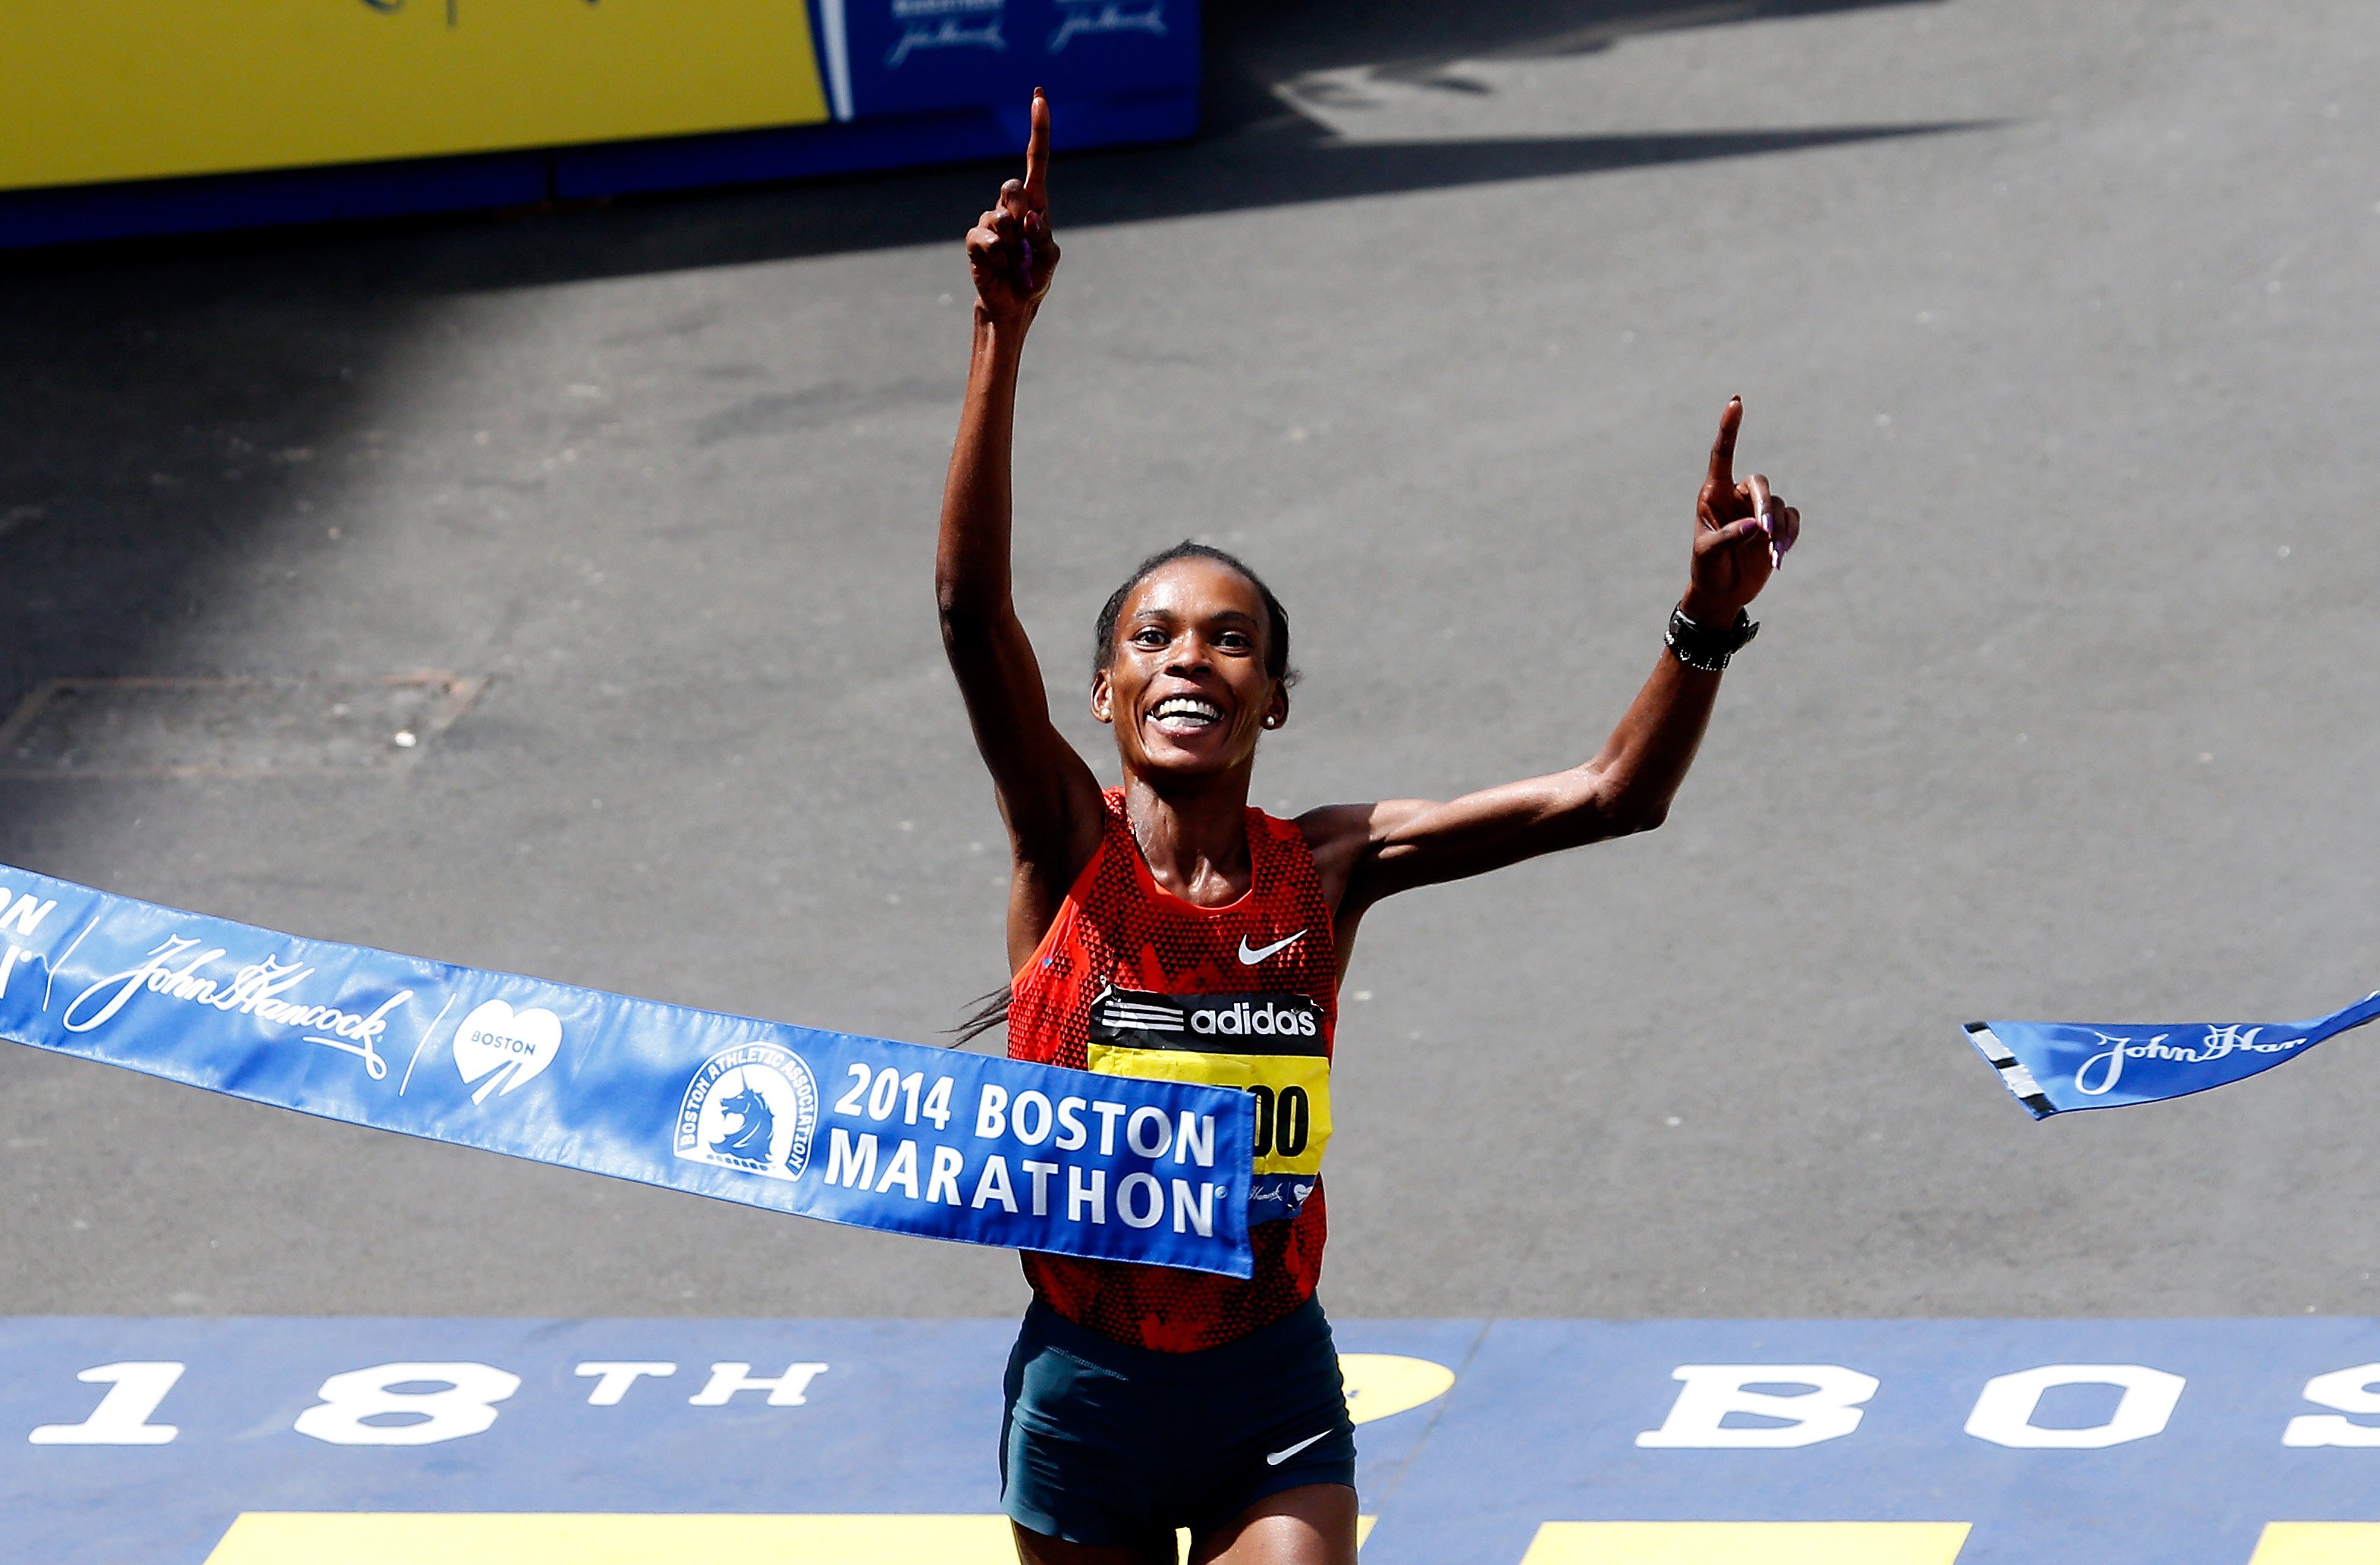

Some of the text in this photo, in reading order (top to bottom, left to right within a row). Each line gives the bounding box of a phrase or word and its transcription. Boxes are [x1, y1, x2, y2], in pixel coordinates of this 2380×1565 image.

[63, 933, 226, 1032] John
[215, 953, 413, 1080] Hancock
[470, 1030, 536, 1056] BOSTON
[1190, 1002, 1317, 1036] adidas
[680, 1047, 814, 1170] BOSTON ATHLETIC ASSOCIATION
[834, 1062, 1215, 1168] 2014 BOSTON
[2075, 1031, 2199, 1096] John
[824, 1127, 1214, 1237] MARATHON
